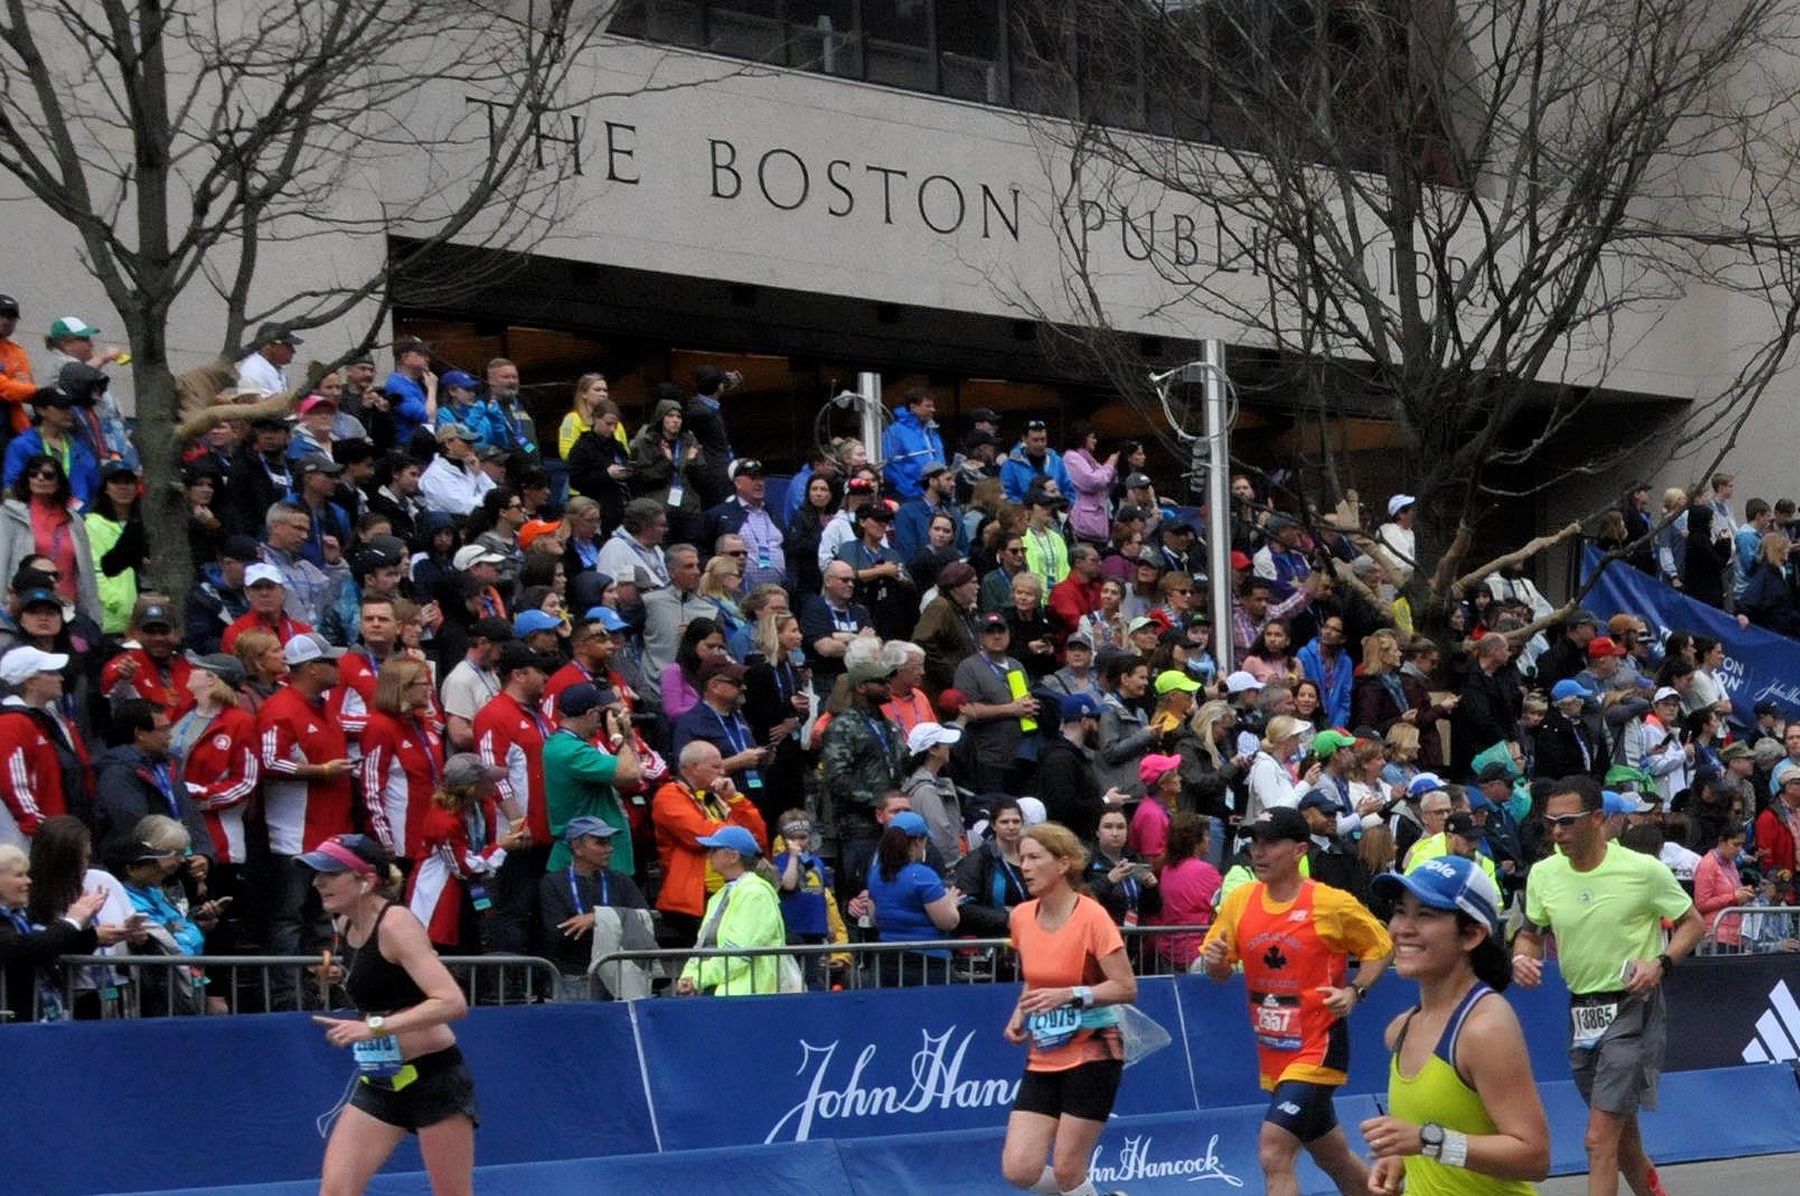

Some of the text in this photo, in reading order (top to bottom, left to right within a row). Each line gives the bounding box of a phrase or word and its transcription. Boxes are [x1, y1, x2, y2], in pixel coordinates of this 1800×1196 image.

[465, 96, 640, 185] THE
[708, 137, 1022, 242] BOSTON
[1575, 1006, 1613, 1031] 13865
[764, 1039, 902, 1143] John
[1117, 1134, 1244, 1188] Hancock
